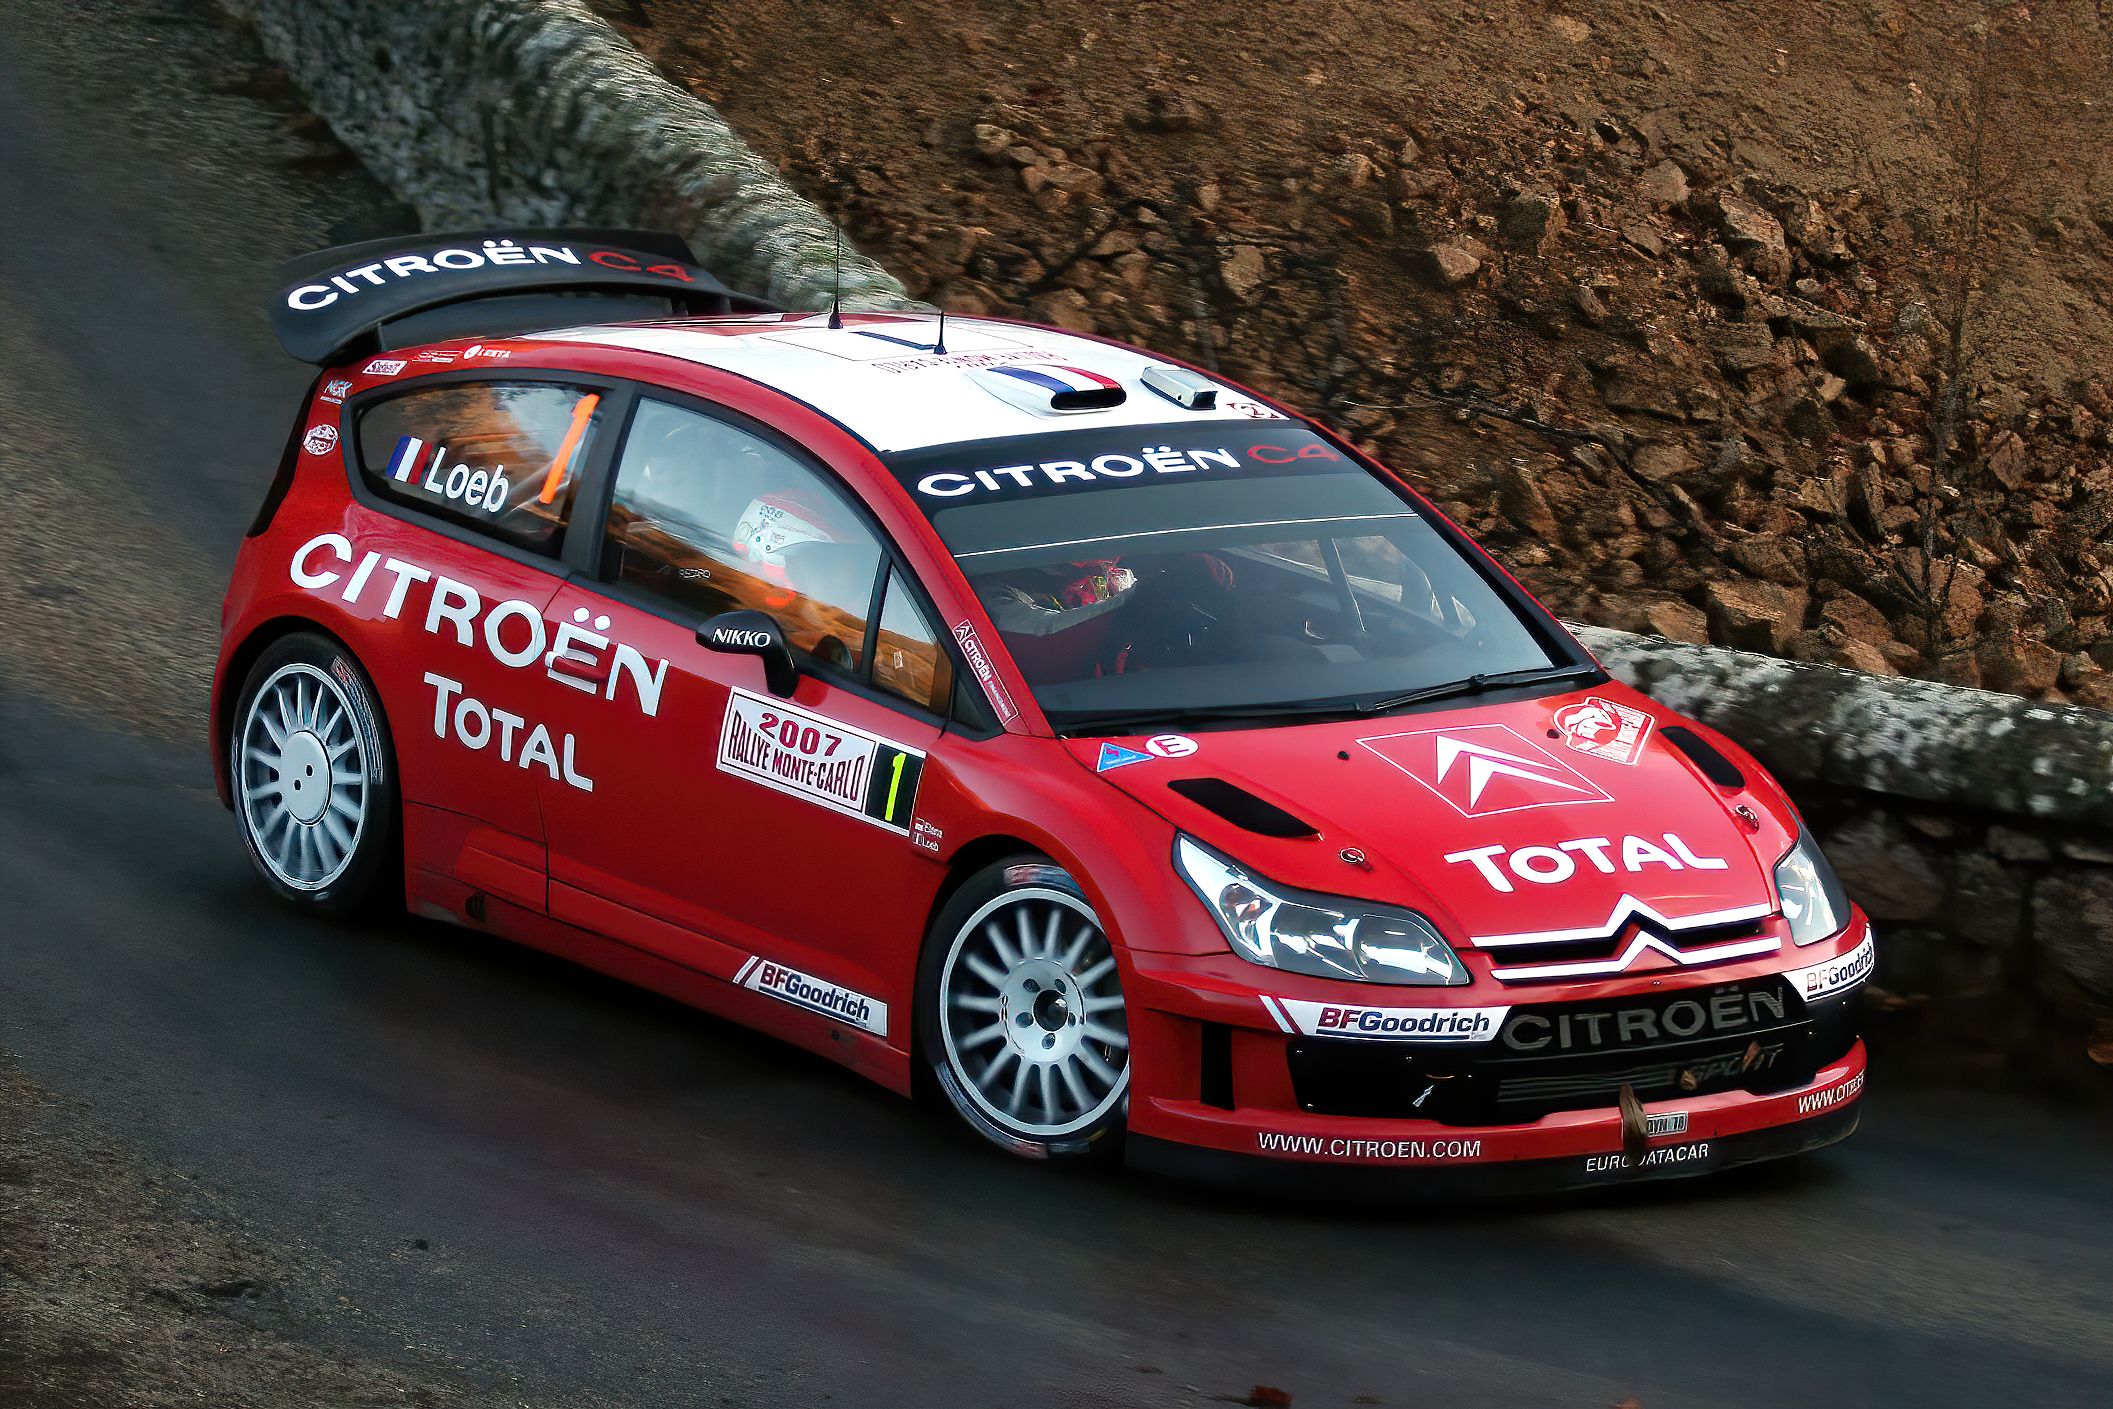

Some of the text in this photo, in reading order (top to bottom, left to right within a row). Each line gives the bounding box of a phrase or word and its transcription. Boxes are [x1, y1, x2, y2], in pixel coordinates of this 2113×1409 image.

[287, 239, 696, 311] CITROËN C4
[425, 446, 510, 514] Loeb
[916, 443, 1340, 497] CITROËN C4
[289, 535, 670, 718] CITROËN
[711, 628, 772, 648] NIKKO
[423, 671, 594, 793] TOTAL
[728, 709, 773, 771] RALLYE
[758, 712, 843, 758] 2007
[884, 752, 907, 822] 1
[1443, 832, 1729, 893] TOTAL
[760, 963, 871, 1022] BFGoodrich
[1317, 1006, 1490, 1034] BFGoodrich
[1502, 985, 1786, 1051] CITROËN
[1258, 1132, 1482, 1159] WWW.CITROEN.COM
